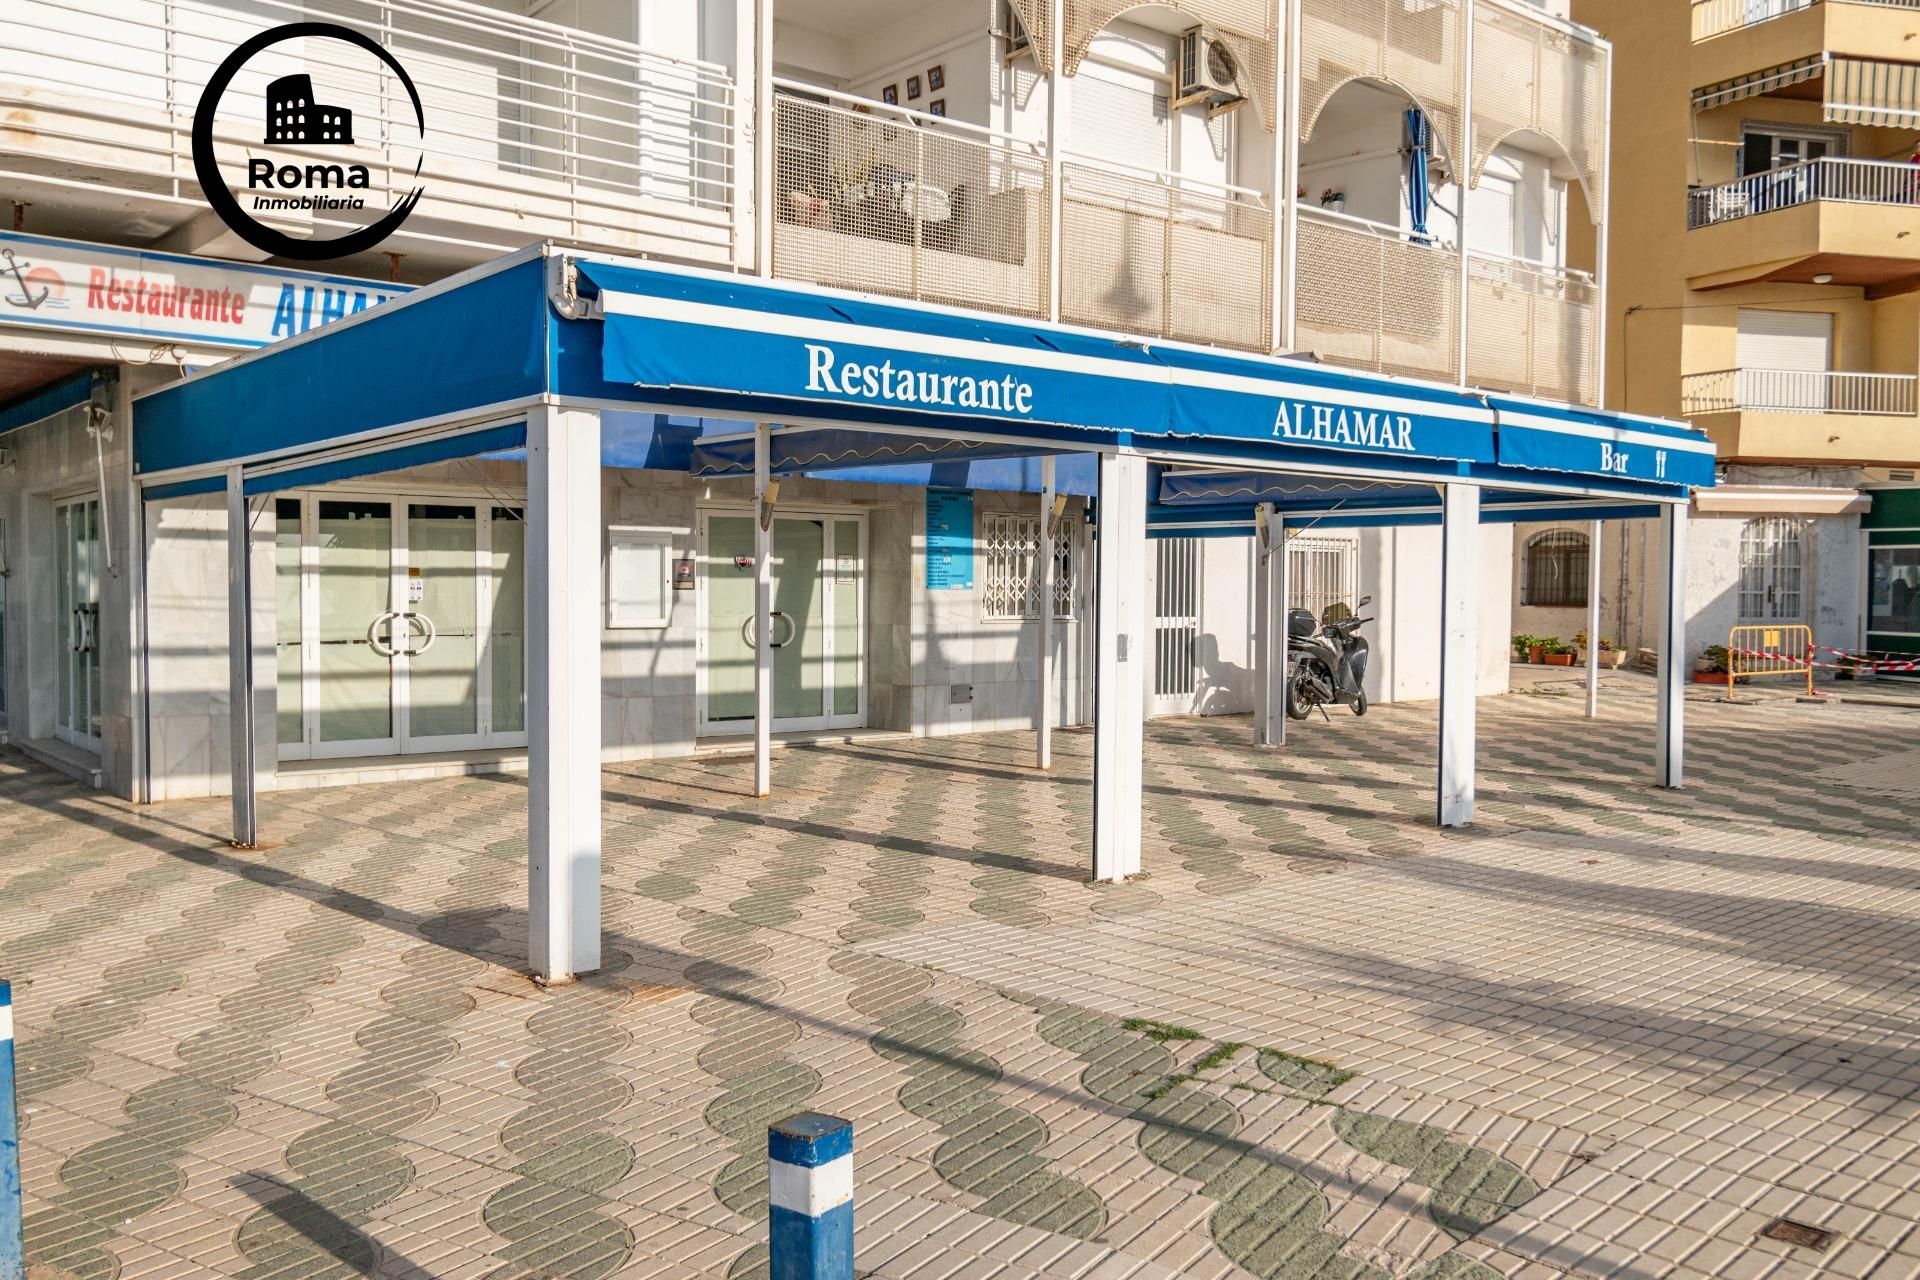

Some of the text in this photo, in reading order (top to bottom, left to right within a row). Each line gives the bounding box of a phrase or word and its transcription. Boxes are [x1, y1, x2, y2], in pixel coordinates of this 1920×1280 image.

[87, 267, 398, 337] Restaurante ALH
[804, 343, 1033, 414] Restaurante
[1272, 400, 1416, 451] ALHAMAR
[1600, 442, 1629, 473] Bar
